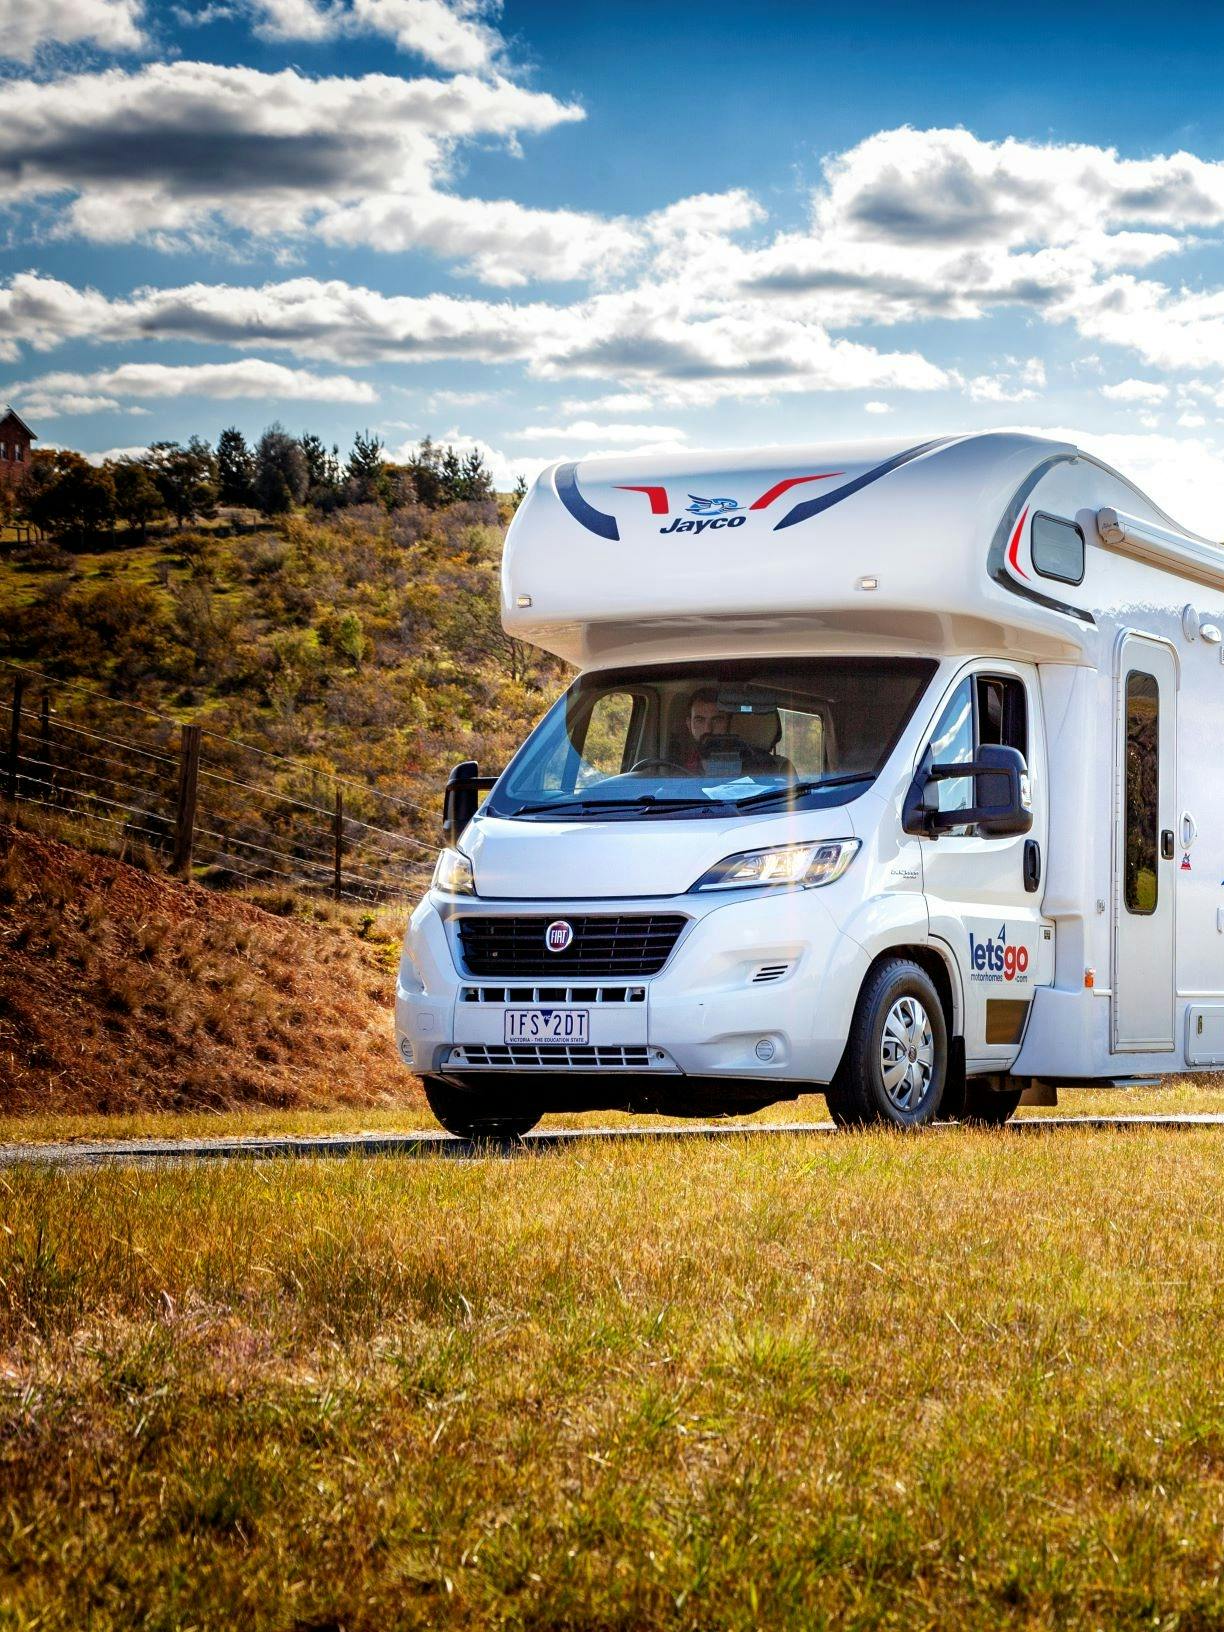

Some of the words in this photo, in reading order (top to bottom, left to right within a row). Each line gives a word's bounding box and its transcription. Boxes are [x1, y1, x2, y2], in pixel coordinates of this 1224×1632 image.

[660, 516, 746, 534] Jayco
[550, 930, 567, 943] FIAT
[970, 971, 1003, 982] motorhomes
